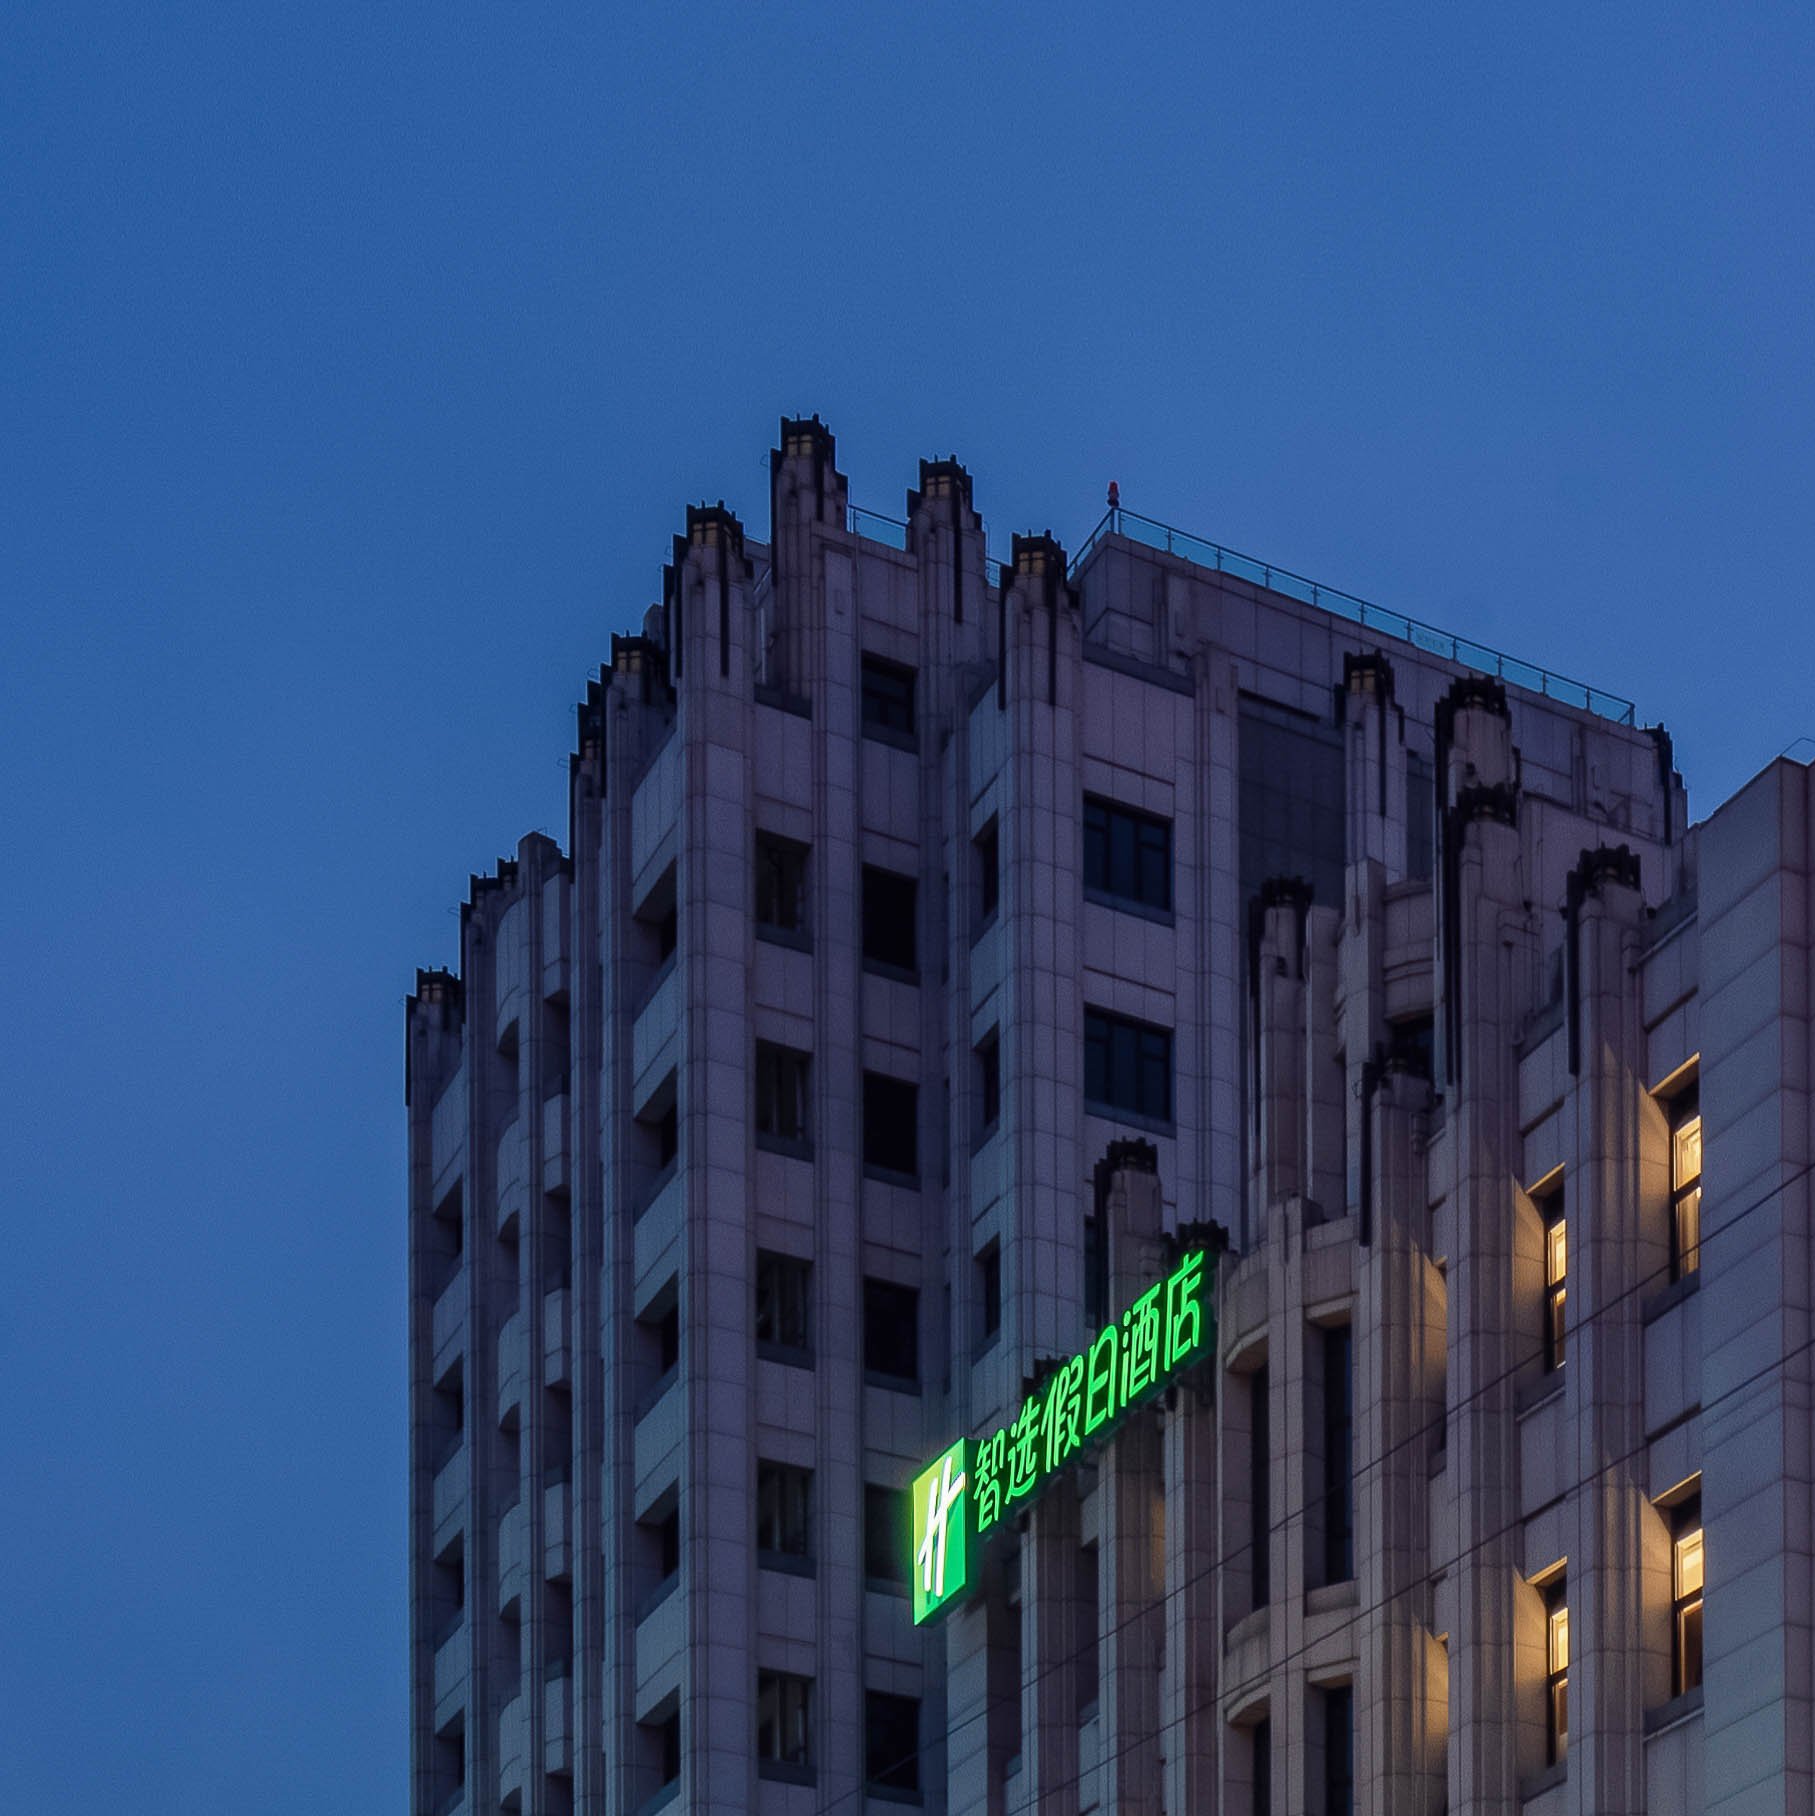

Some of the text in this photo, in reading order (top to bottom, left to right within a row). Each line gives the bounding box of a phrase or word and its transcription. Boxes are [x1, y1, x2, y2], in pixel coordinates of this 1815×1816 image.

[973, 1250, 1204, 1533] 智选假日酒店
